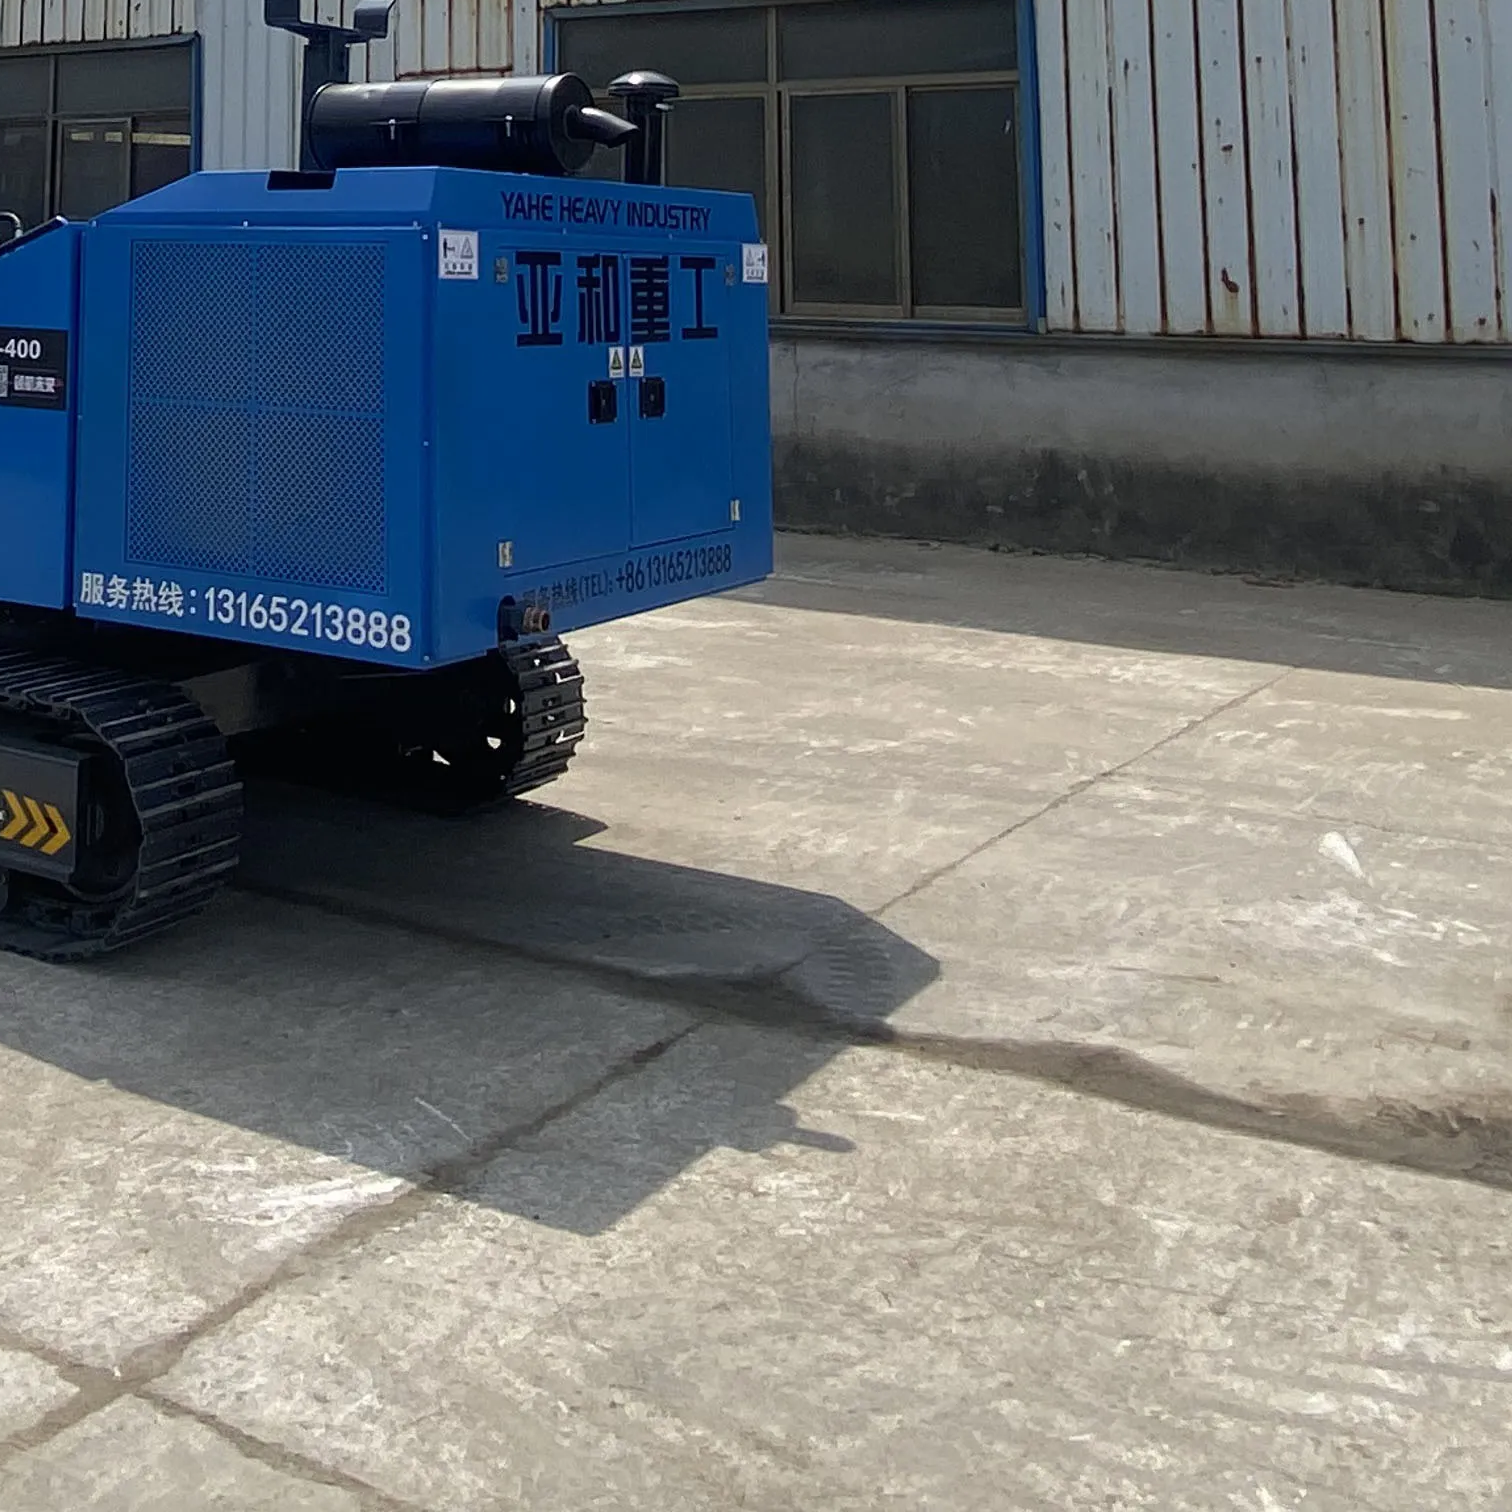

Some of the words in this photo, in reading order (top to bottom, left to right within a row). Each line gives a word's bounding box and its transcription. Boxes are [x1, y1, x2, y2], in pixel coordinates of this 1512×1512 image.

[500, 191, 553, 221] YAHE
[559, 195, 622, 225] HEAVY
[627, 201, 711, 231] INDUSTRY
[515, 251, 718, 347] 亚和重工
